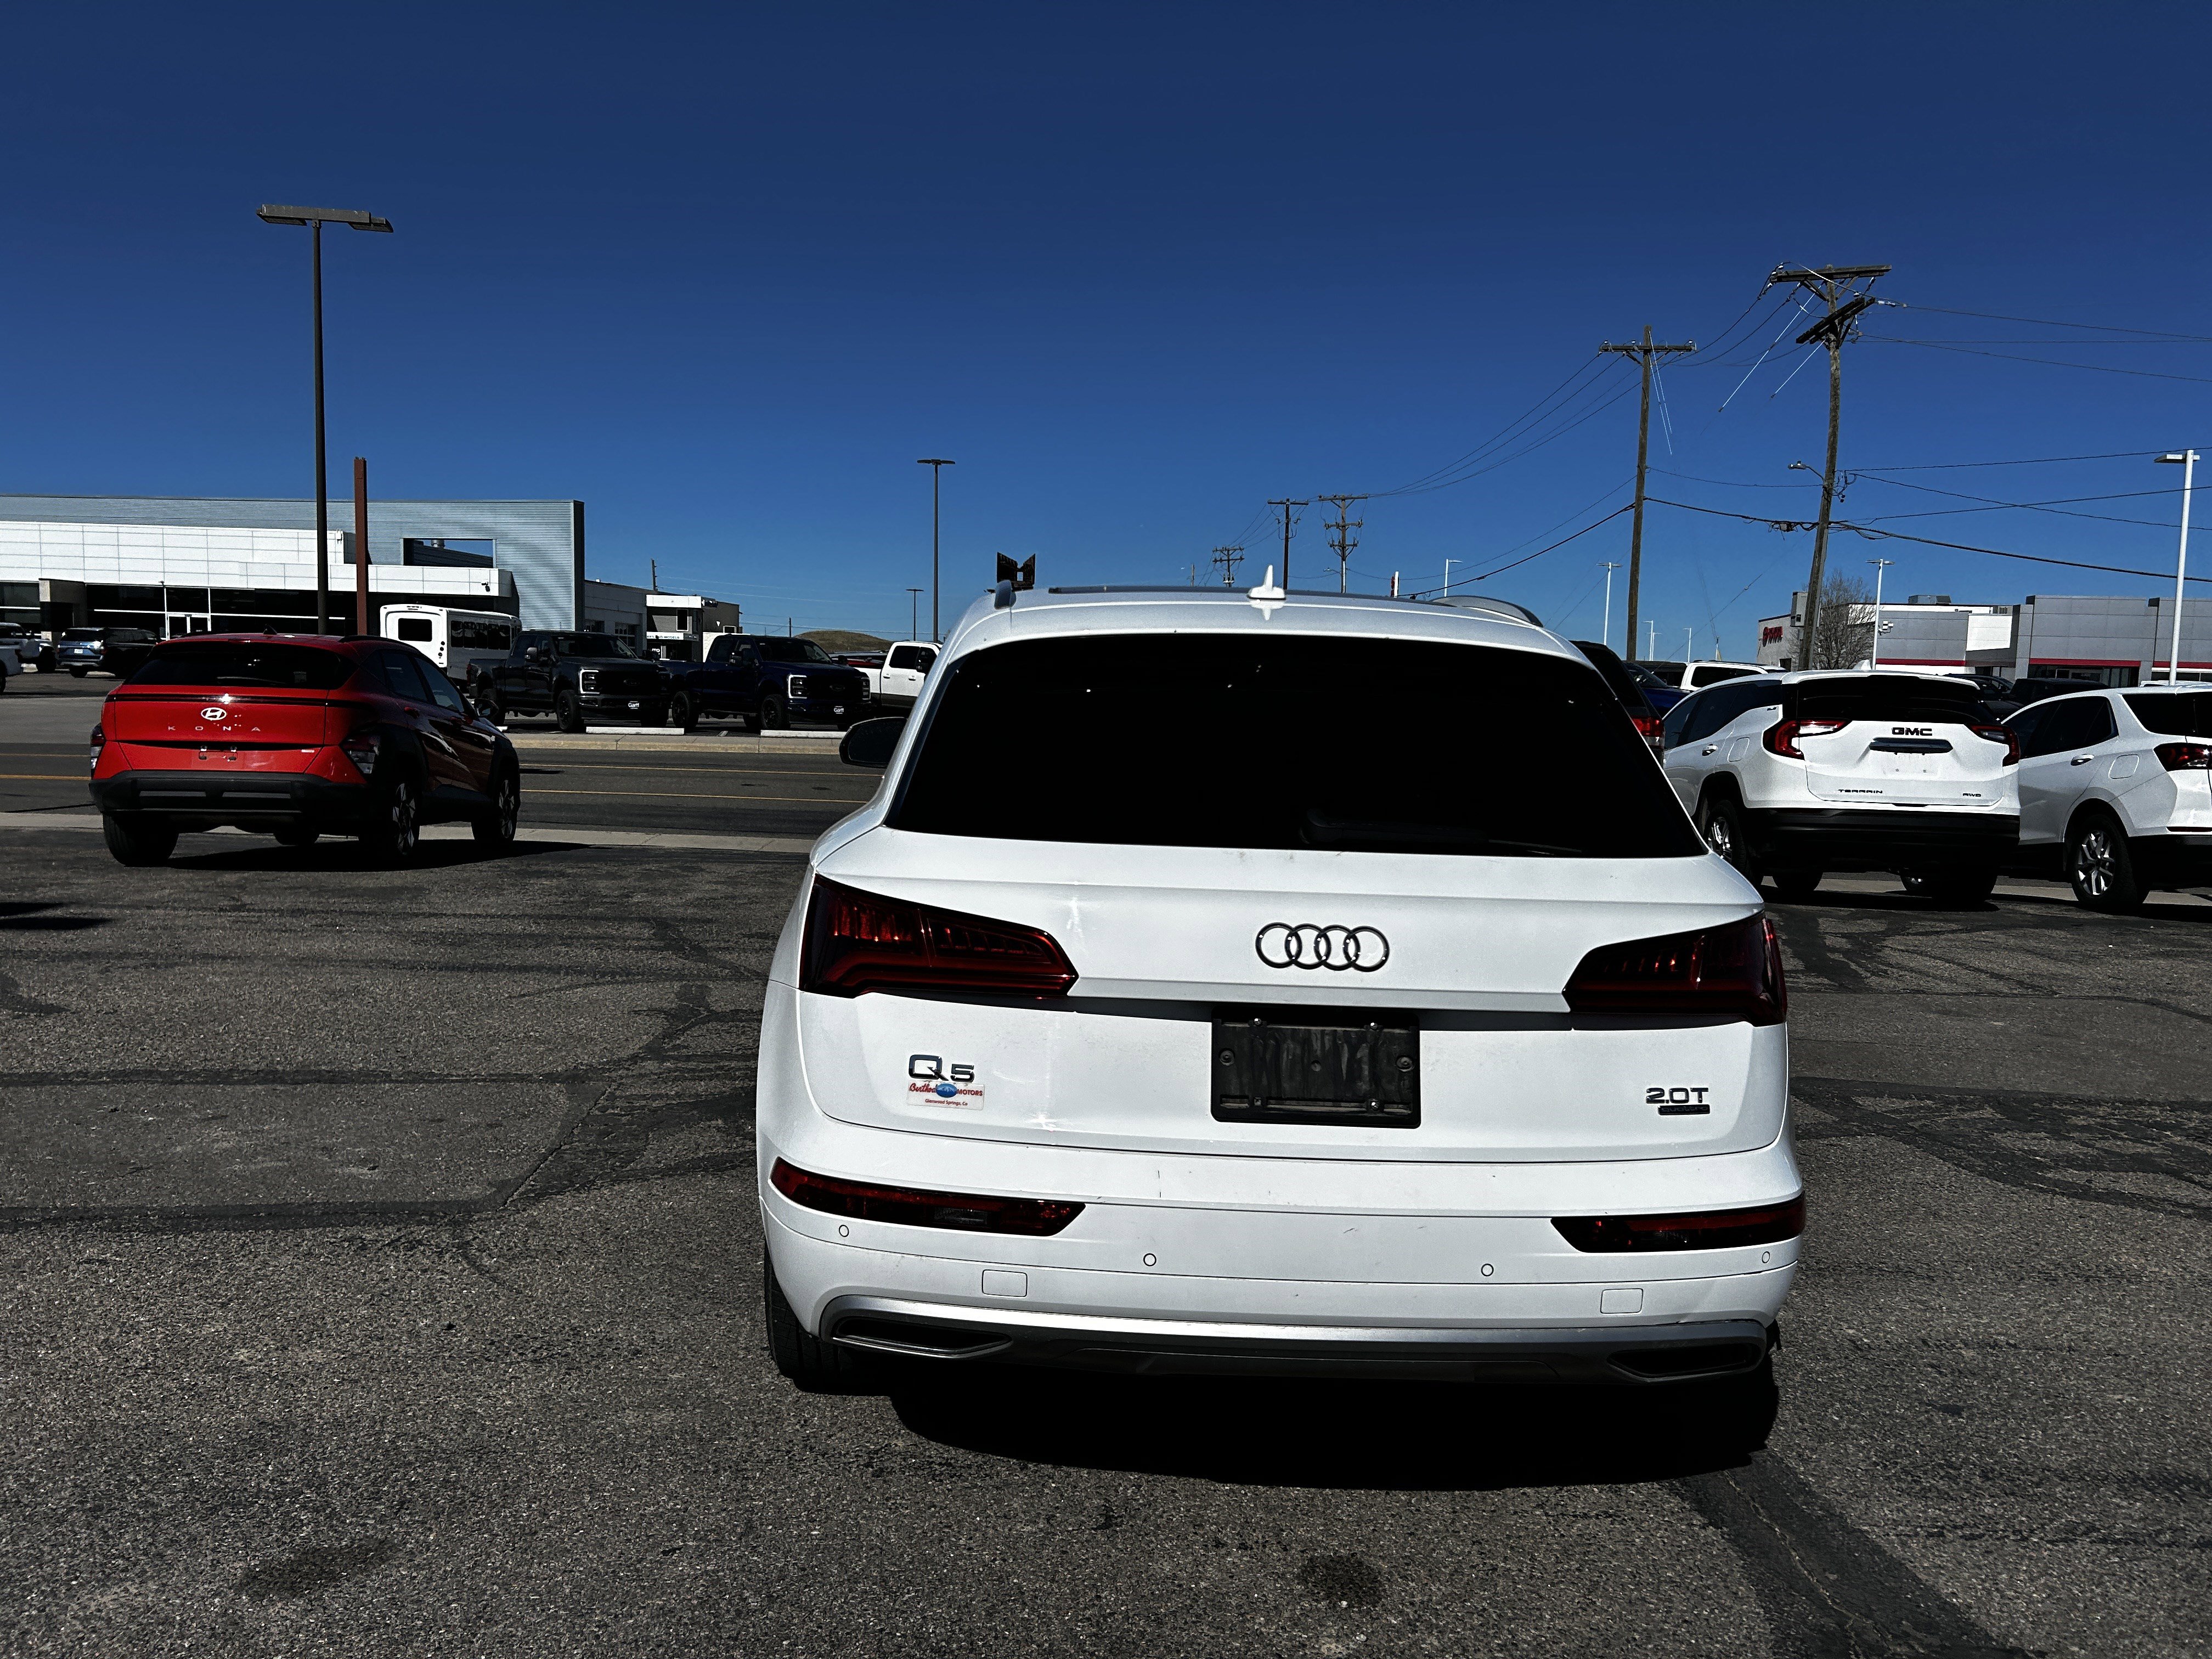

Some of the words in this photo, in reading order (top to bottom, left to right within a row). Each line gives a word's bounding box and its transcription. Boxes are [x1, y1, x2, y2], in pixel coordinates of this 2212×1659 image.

[1892, 727, 1932, 736] GMC
[909, 1054, 975, 1083] Q5
[957, 1088, 983, 1097] MOTORS
[1646, 1087, 1709, 1104] 2.0T
